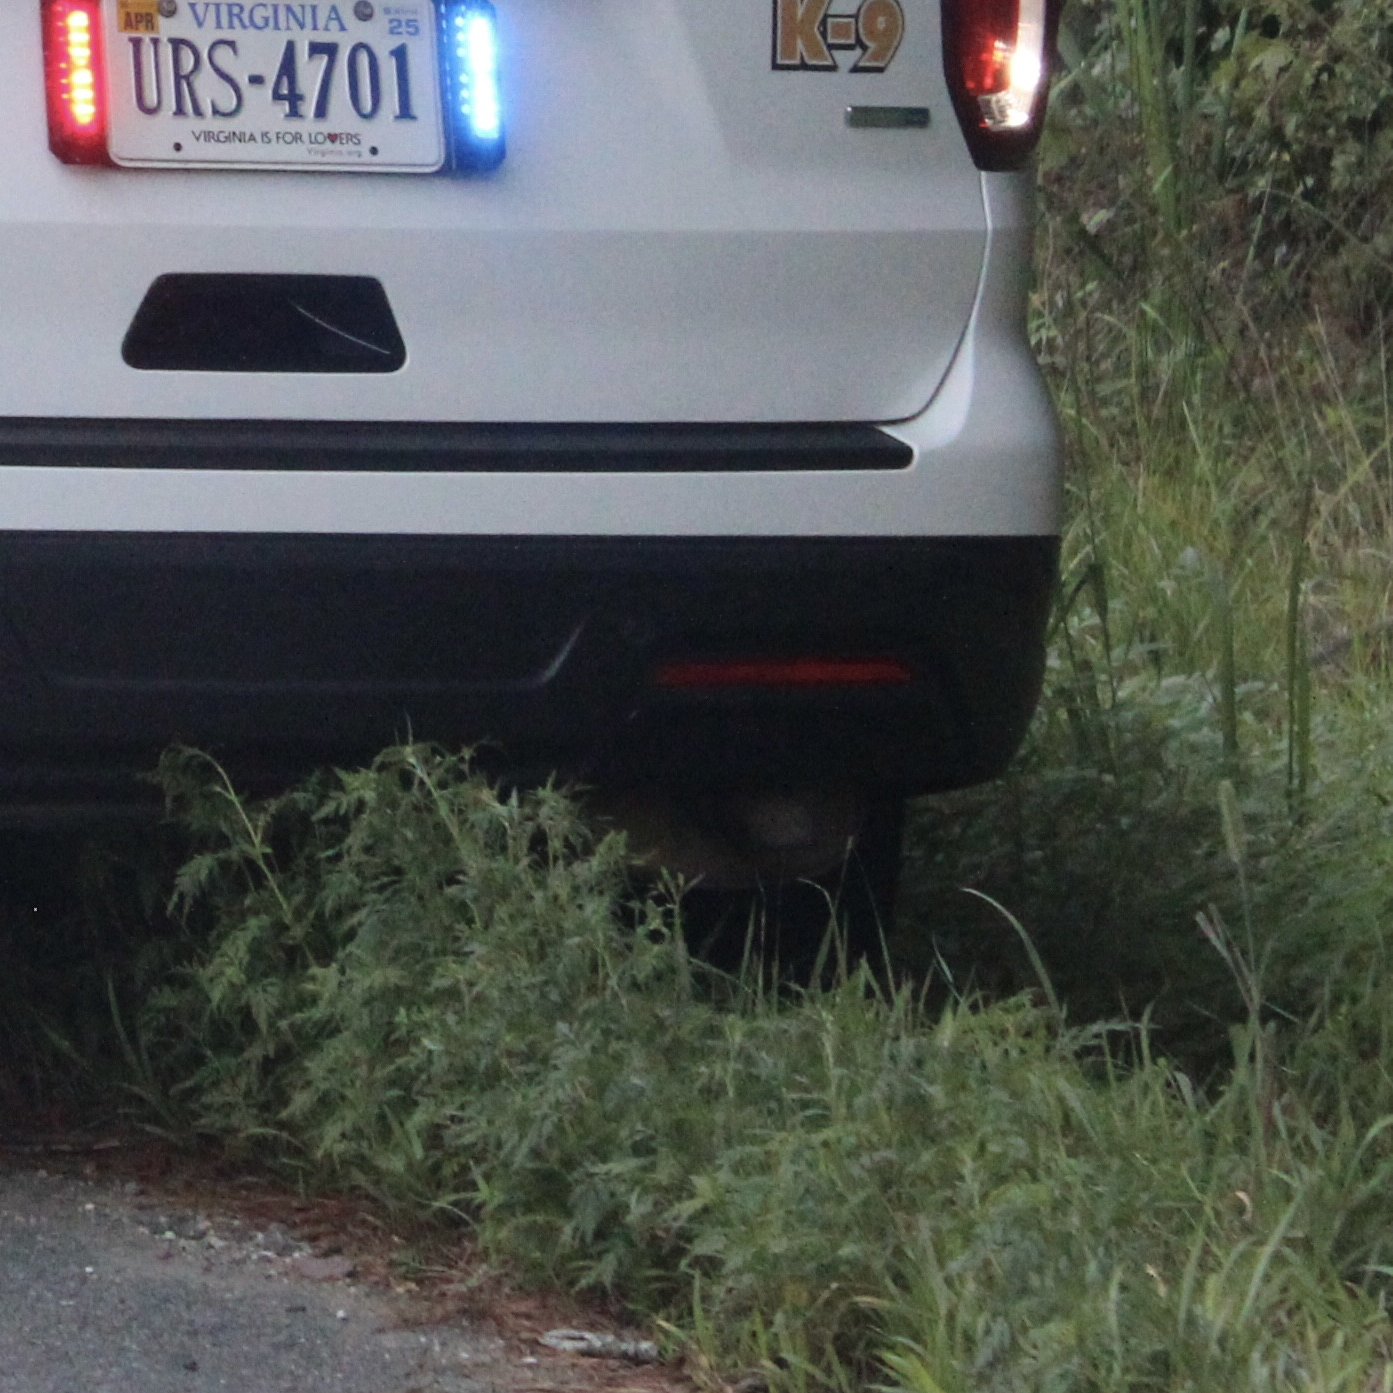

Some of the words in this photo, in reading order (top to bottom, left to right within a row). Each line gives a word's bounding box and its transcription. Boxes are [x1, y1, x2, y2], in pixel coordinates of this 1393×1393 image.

[123, 11, 155, 31] APR
[187, 1, 348, 33] VIRGINIA
[388, 18, 421, 36] 25
[126, 36, 420, 122] URS-4701
[191, 130, 257, 144] VIRGINIA
[261, 131, 272, 144] IS
[276, 132, 304, 145] FOR
[306, 146, 362, 158] Virginiaorg
